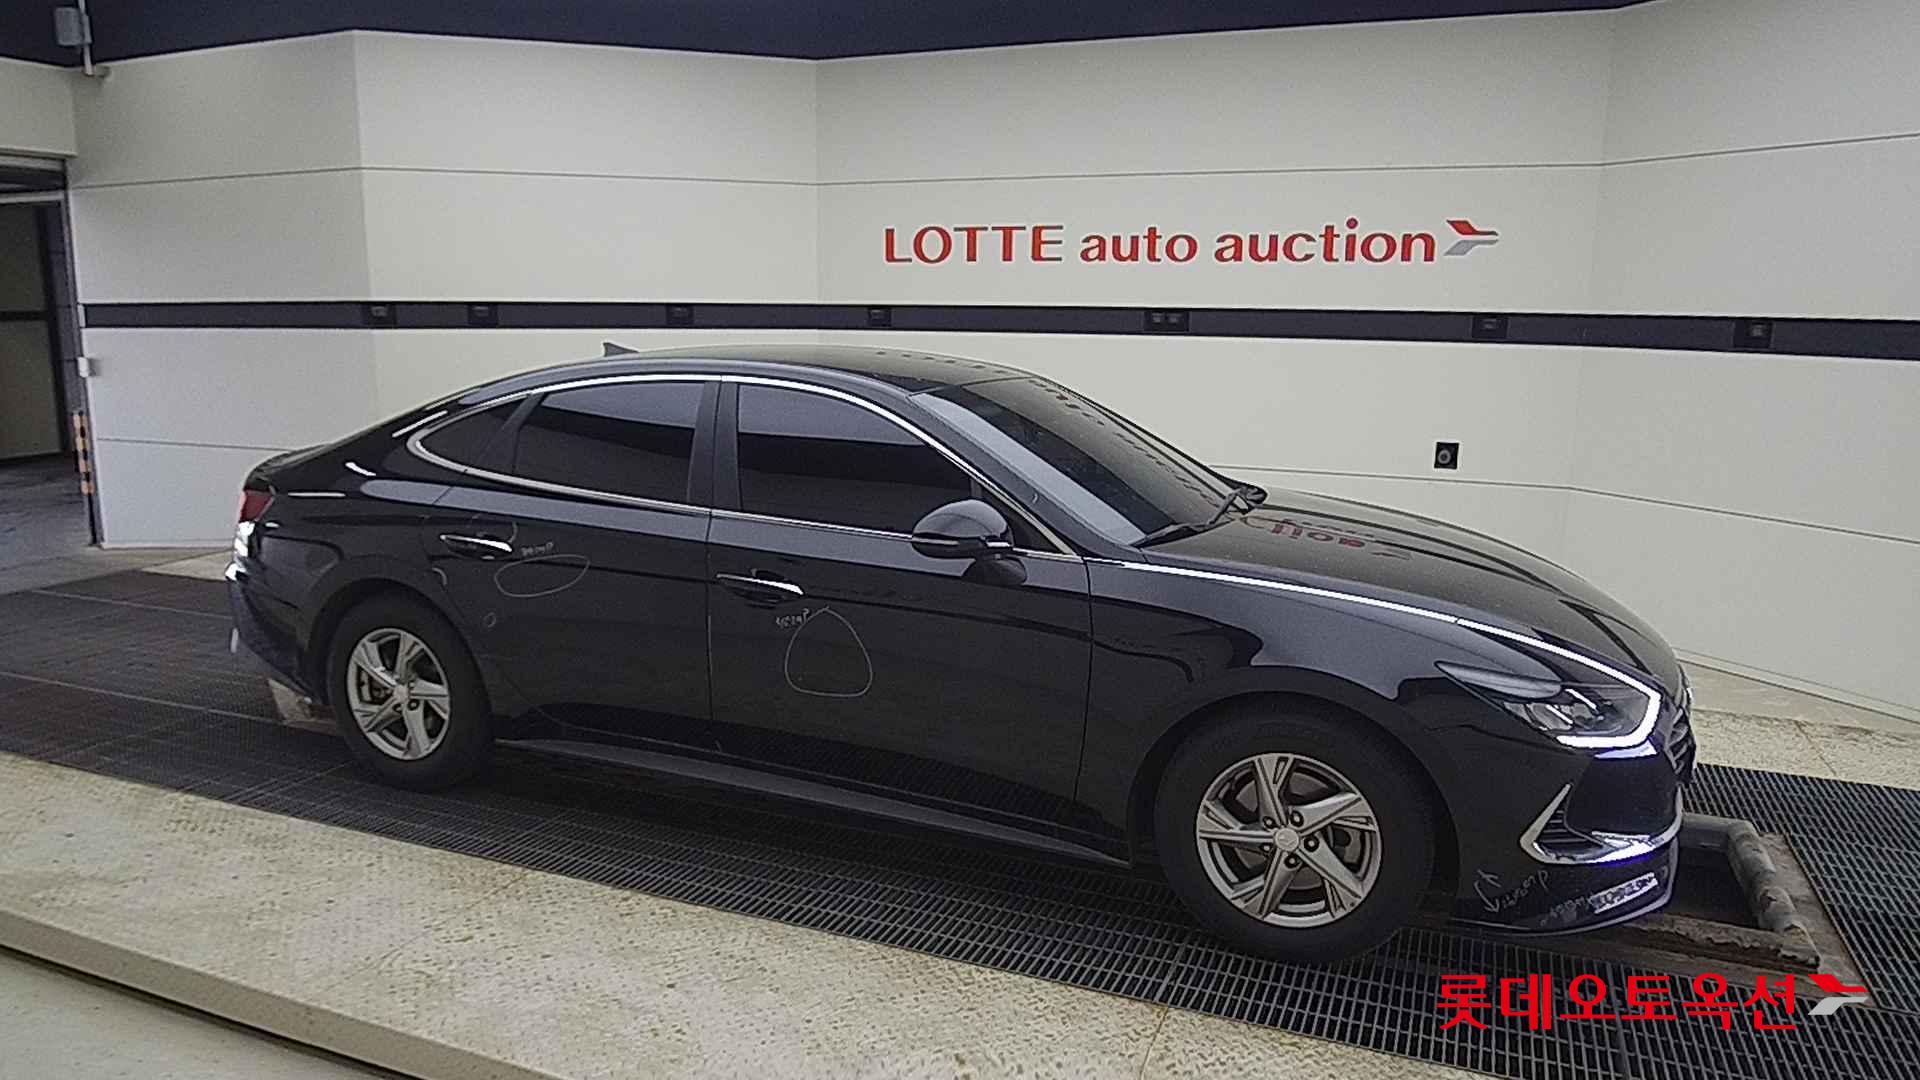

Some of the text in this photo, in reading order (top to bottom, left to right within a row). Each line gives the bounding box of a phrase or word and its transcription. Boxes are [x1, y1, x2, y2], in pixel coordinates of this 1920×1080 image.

[884, 218, 1436, 263] LOTTE auto auction
